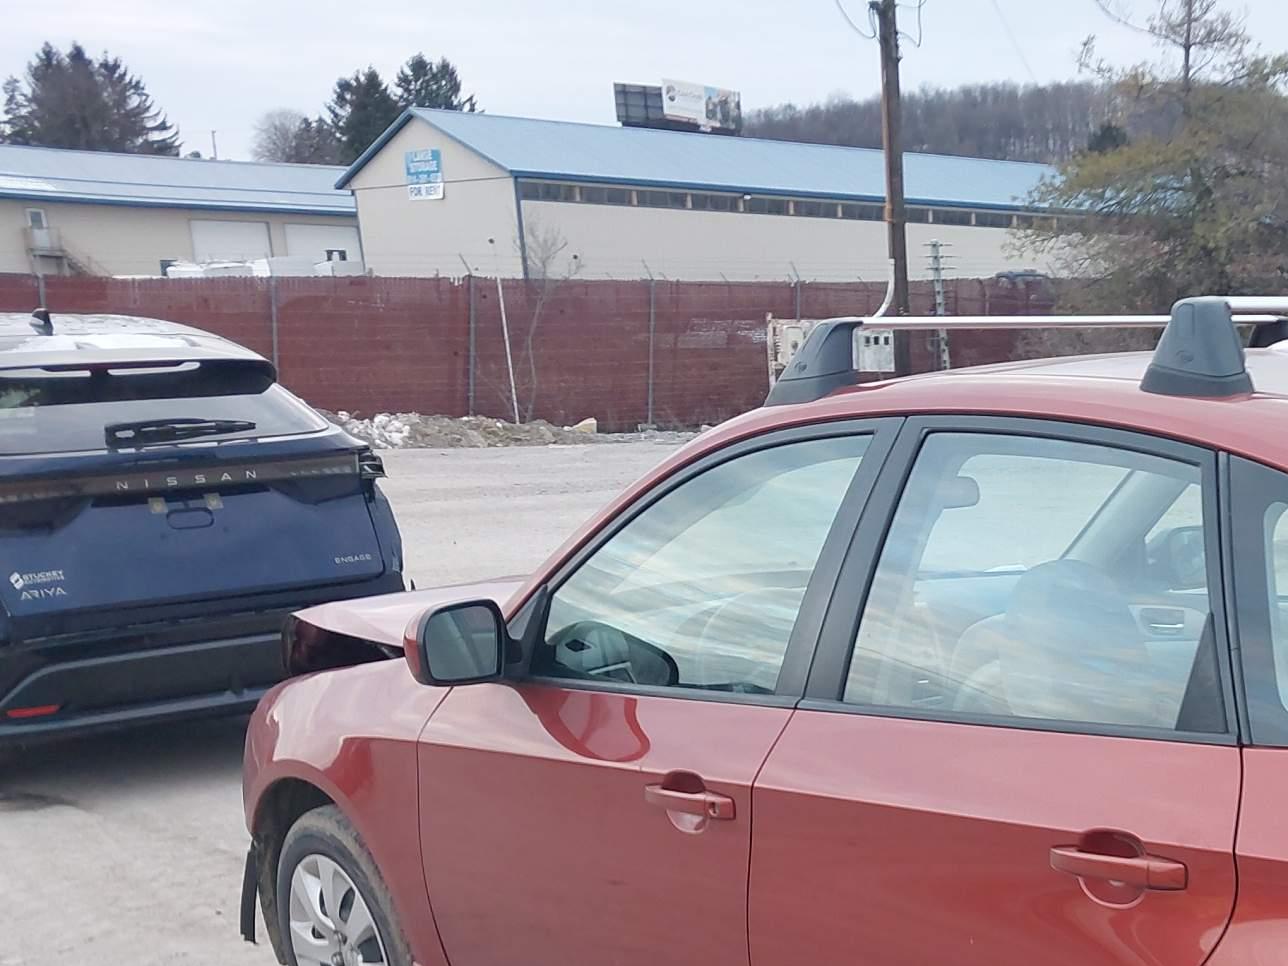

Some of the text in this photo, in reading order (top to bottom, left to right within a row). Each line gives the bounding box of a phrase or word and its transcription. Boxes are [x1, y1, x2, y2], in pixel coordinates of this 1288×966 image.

[409, 186, 423, 197] FOR
[116, 470, 257, 490] NISSAN
[21, 587, 67, 600] ARIYA
